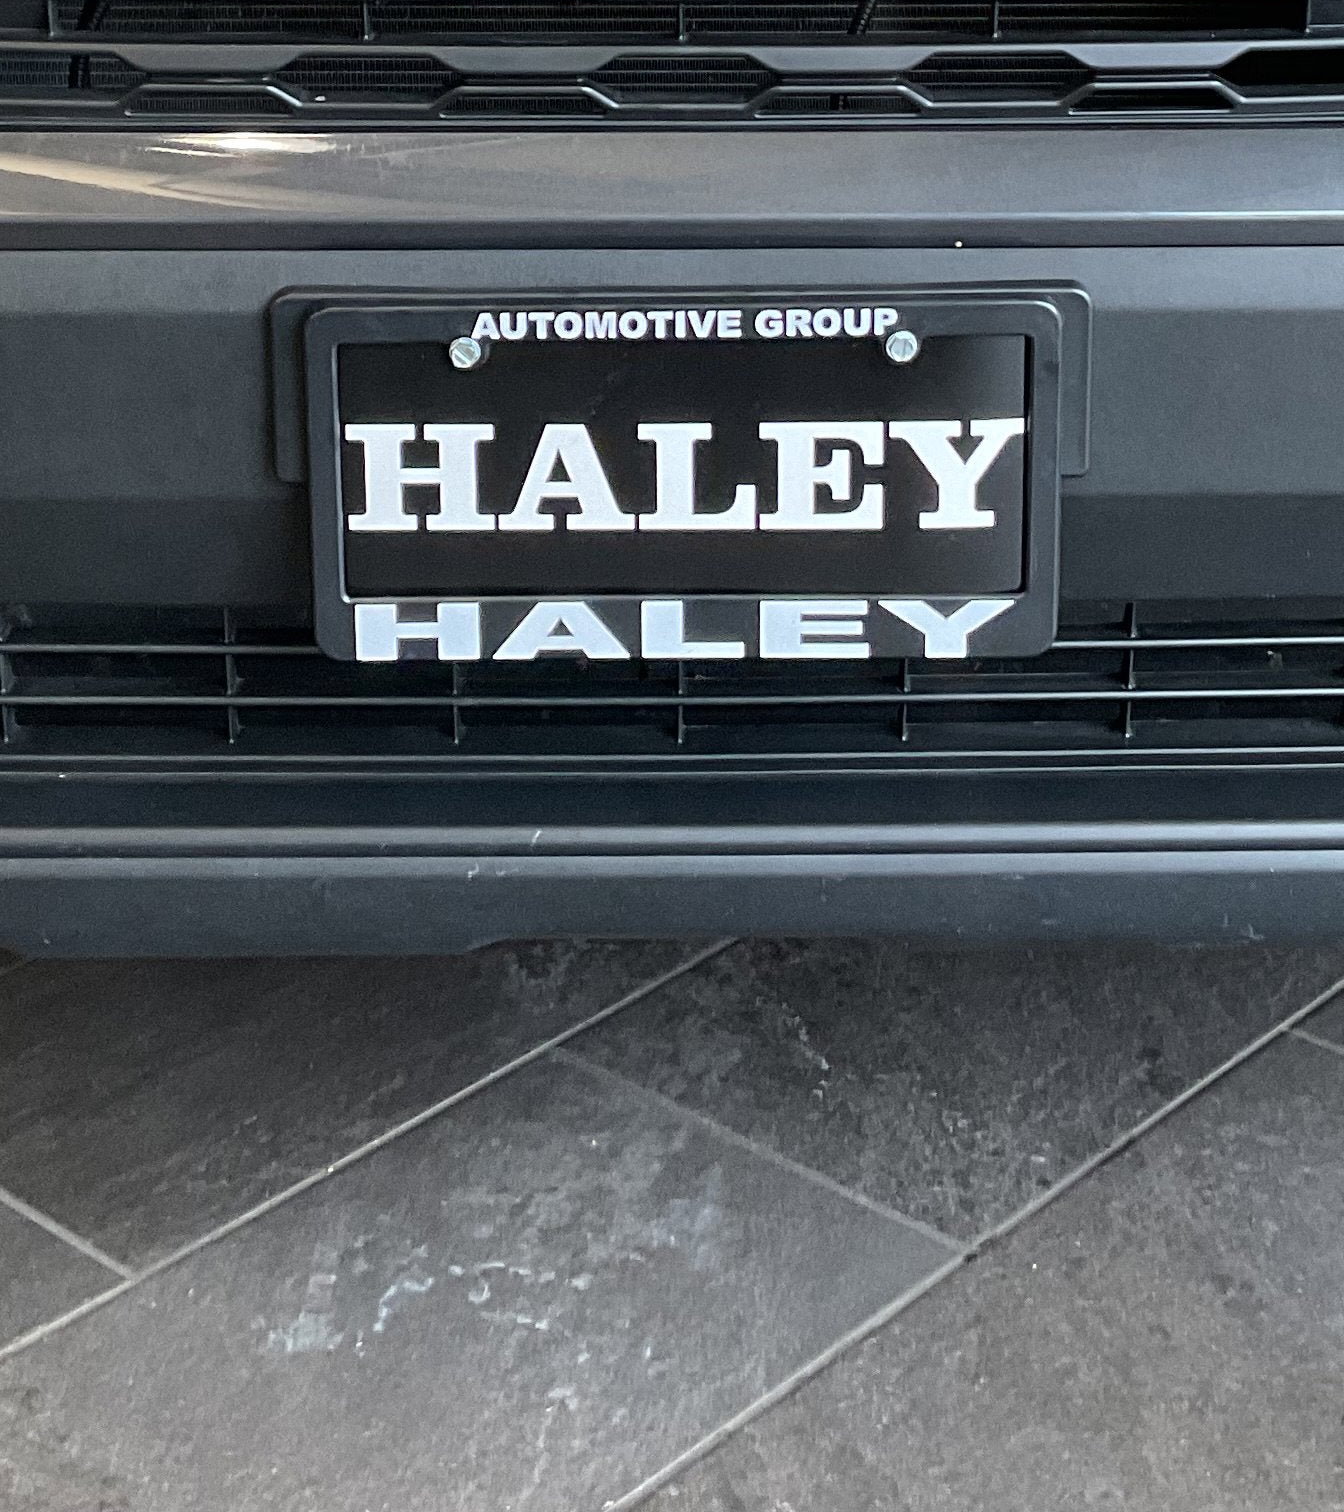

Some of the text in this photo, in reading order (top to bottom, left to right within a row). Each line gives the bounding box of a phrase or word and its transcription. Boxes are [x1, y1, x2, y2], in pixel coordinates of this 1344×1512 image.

[472, 307, 899, 340] AUTOMOTIVE GROUP
[344, 417, 1026, 531] HALEY
[353, 599, 1015, 662] HALEY
